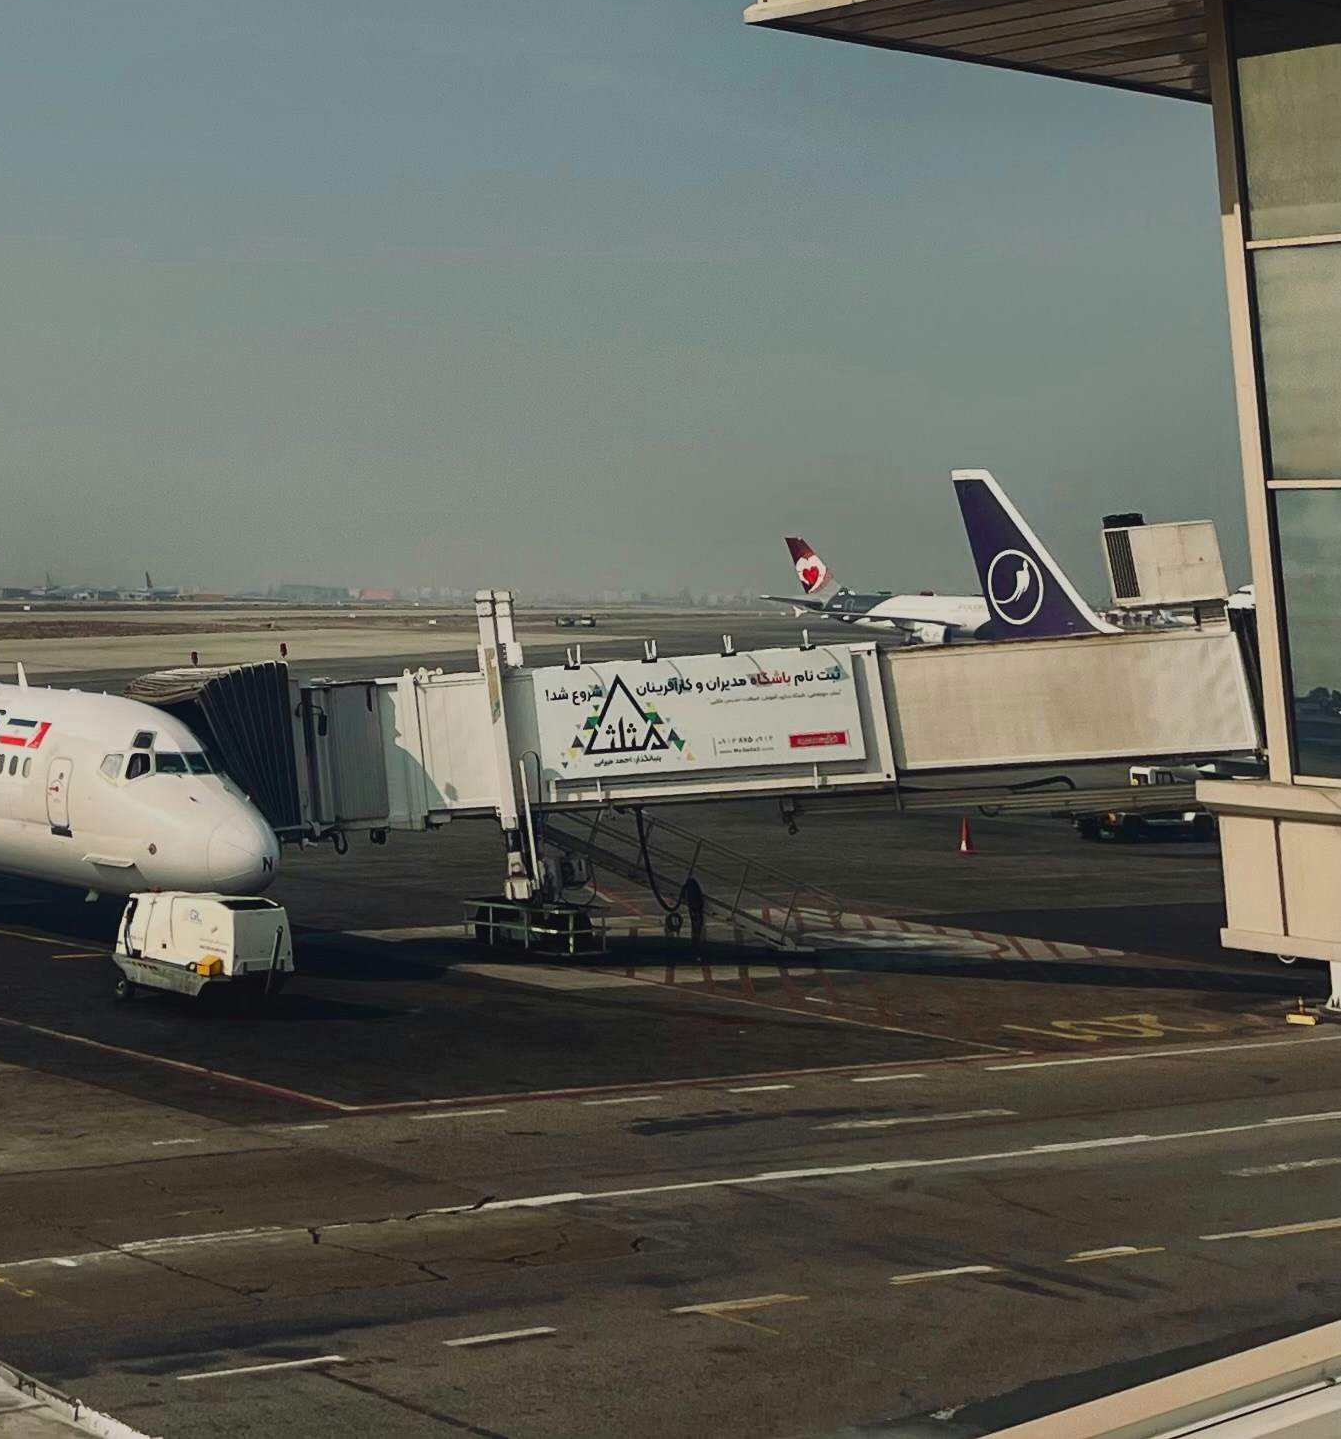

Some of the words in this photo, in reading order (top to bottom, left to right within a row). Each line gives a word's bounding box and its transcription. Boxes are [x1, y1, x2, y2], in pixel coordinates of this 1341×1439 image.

[750, 670, 791, 686] باشگاه
[794, 670, 814, 686] نام
[815, 666, 841, 683] ثبت
[635, 678, 693, 696] کارآفرینان
[695, 681, 704, 694] و
[706, 676, 747, 692] مدیران
[545, 687, 569, 702] شد!
[572, 684, 603, 706] شروع
[262, 856, 274, 872] N
